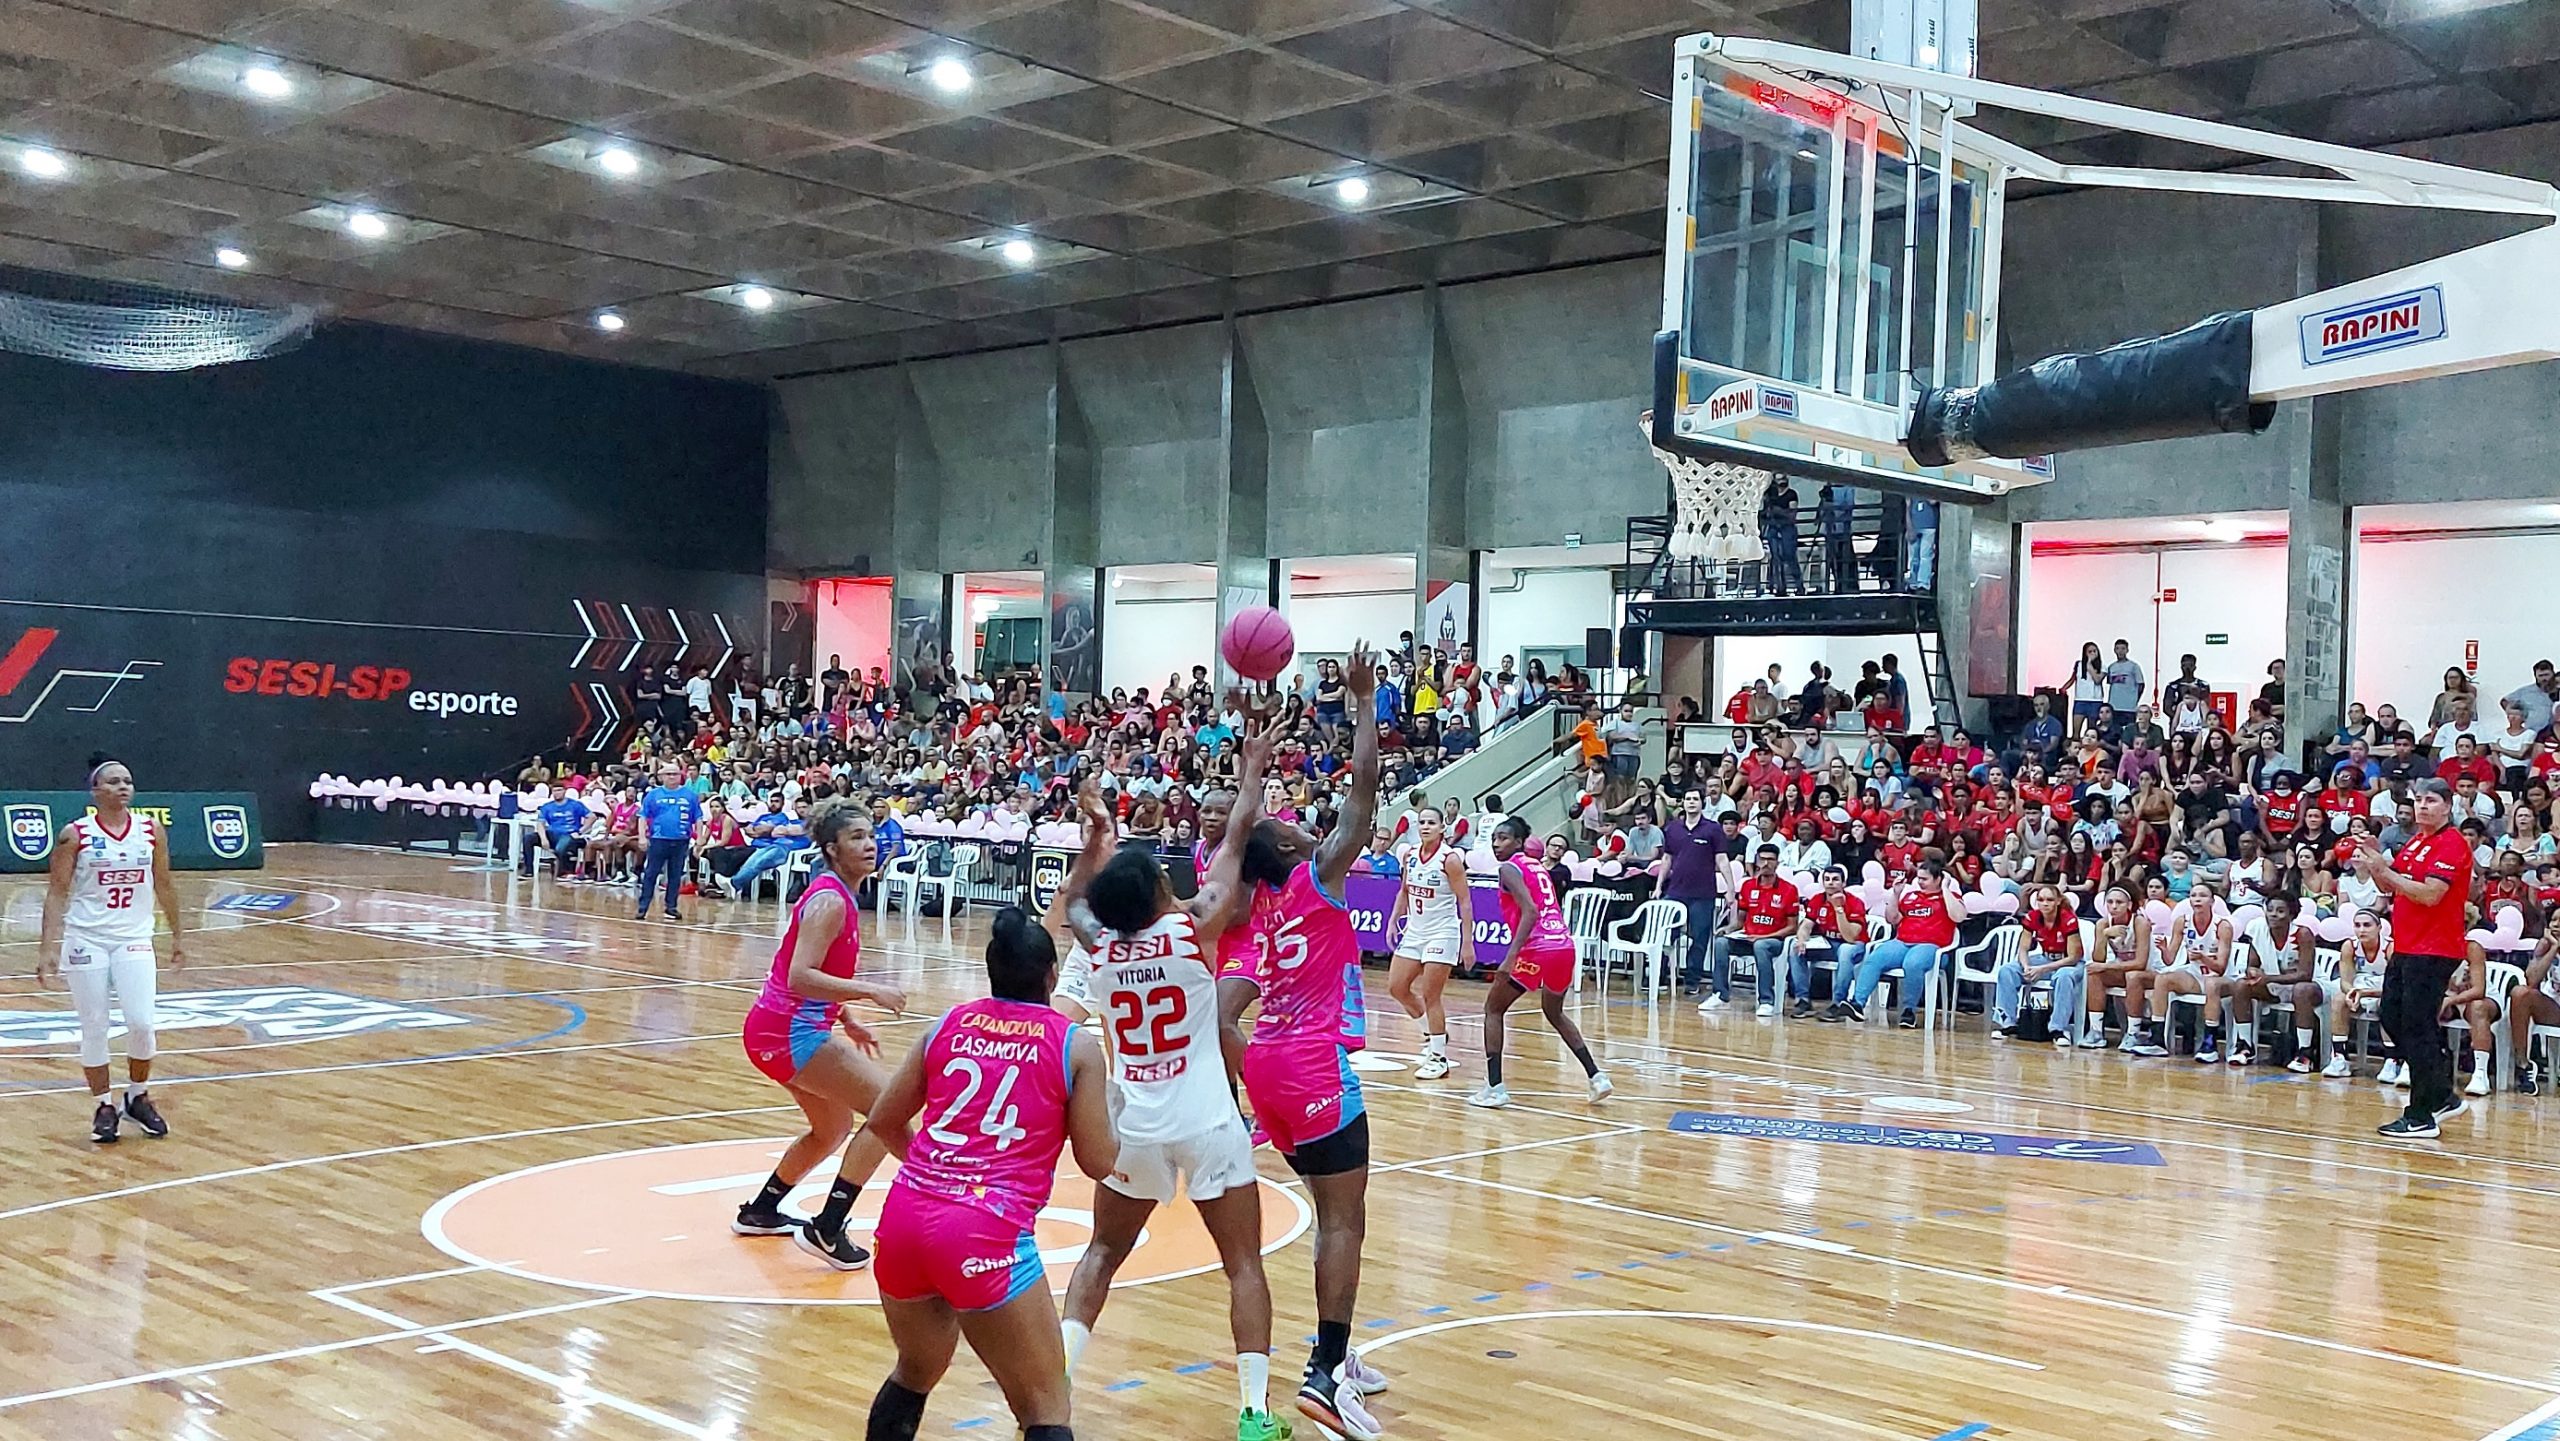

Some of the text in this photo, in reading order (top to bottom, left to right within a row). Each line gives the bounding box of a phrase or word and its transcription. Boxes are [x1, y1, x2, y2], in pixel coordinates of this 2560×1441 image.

[2322, 305, 2419, 347] RAPINI
[1711, 388, 1753, 421] RAPINI
[223, 656, 518, 718] SESI-SP esporte
[2268, 808, 2295, 820] SESI
[101, 871, 141, 885] SESI
[1536, 873, 1556, 906] 9
[106, 887, 133, 909] 32
[1409, 887, 1433, 899] SESI
[1415, 899, 1424, 916] 9
[1349, 909, 1383, 933] 023
[1471, 921, 1513, 945] 2023
[1752, 915, 1773, 926] SESI
[1111, 935, 1166, 961] SESI
[1116, 966, 1166, 986] VITORIA
[960, 1012, 1045, 1040] CATANDUVA
[1110, 985, 1191, 1056] 22
[951, 1033, 1038, 1064] CASANOVA
[1126, 1057, 1183, 1082] FIESP
[927, 1057, 1027, 1152] 24
[1689, 1123, 1996, 1152] FORMAÇÃO DE ATLETAS
[1898, 1128, 1994, 1145] CBC
